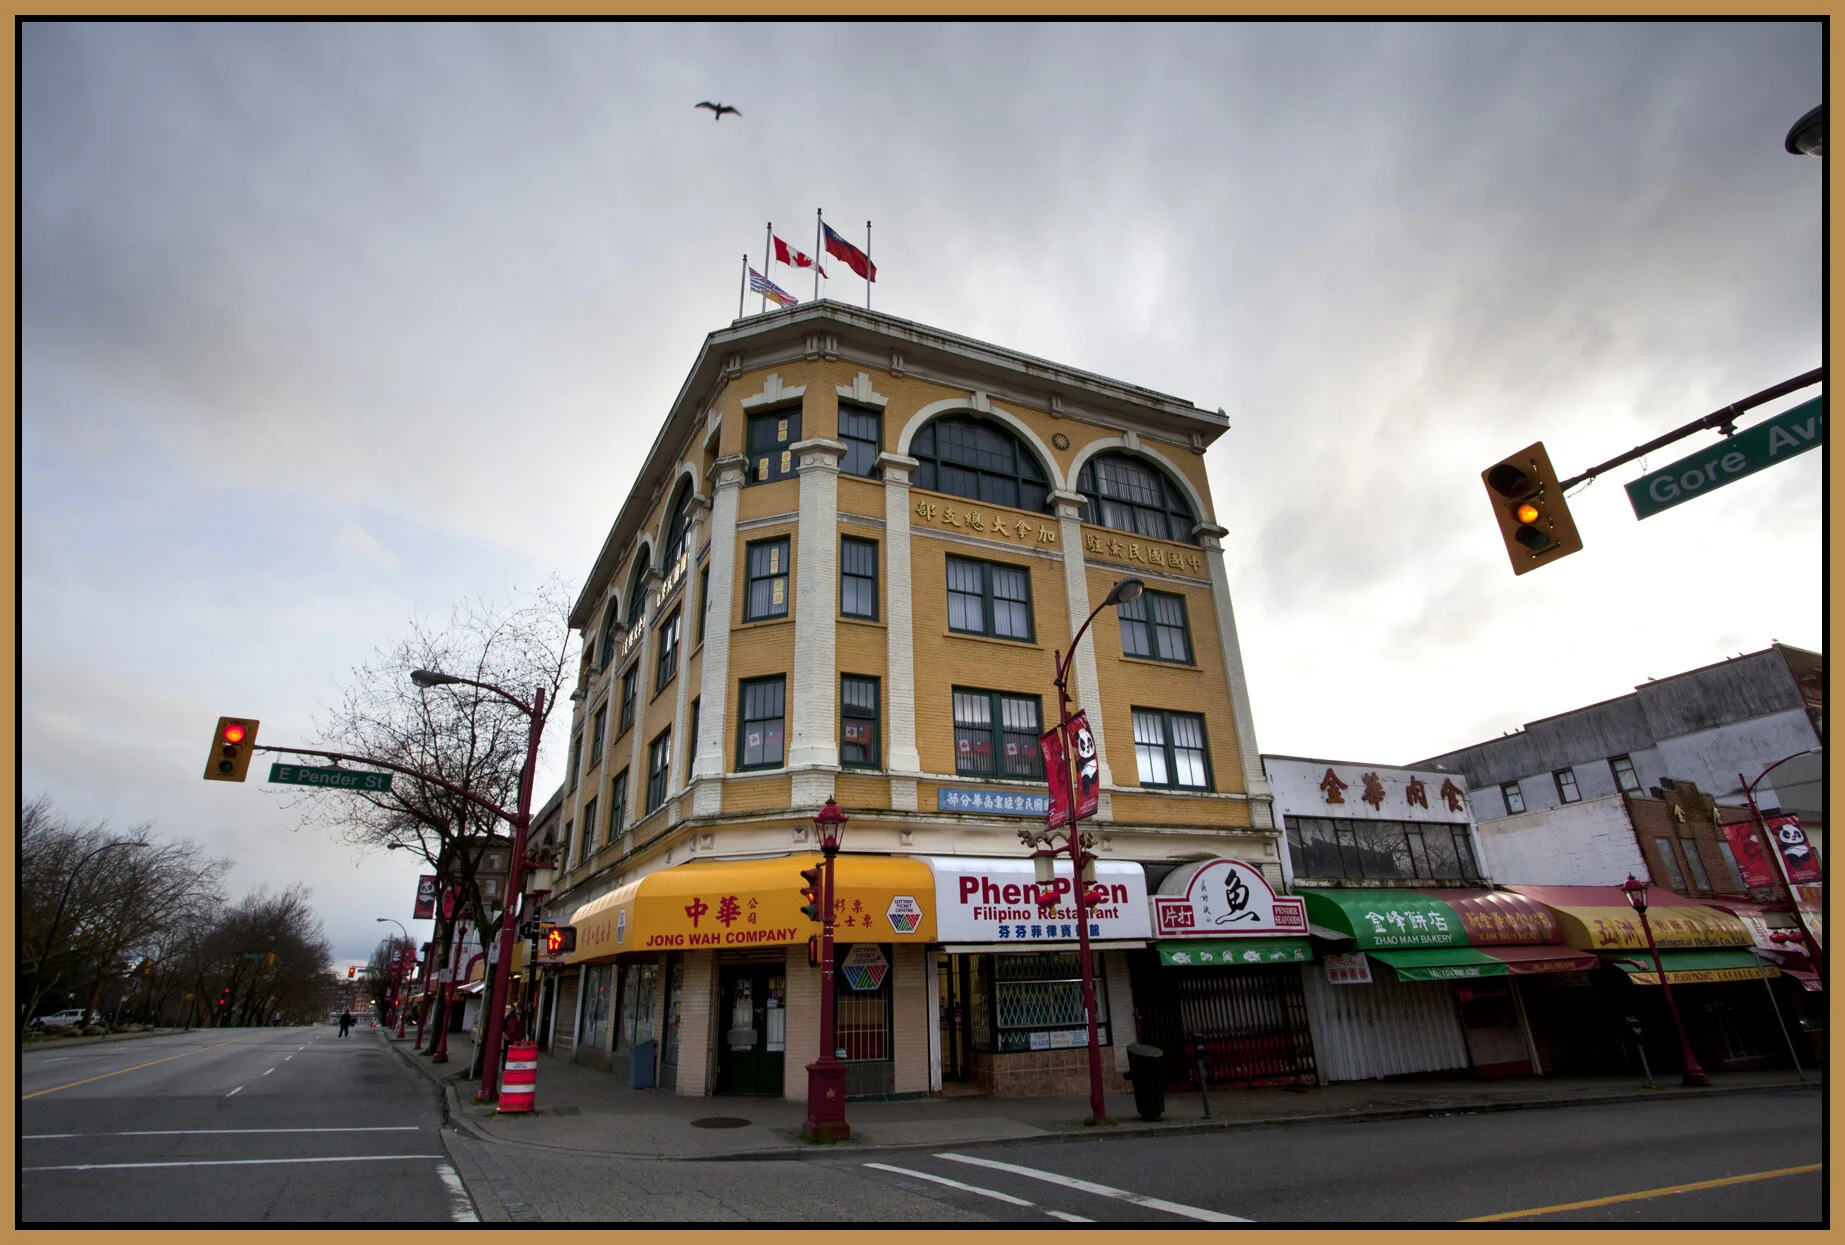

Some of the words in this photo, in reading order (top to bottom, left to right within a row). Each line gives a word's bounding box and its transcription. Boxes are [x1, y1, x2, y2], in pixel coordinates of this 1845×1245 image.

[1649, 450, 1747, 502] Gore
[1769, 413, 1822, 457] Av
[279, 767, 292, 780] E
[298, 769, 358, 787] Pender
[364, 775, 384, 789] St
[1320, 768, 1464, 812] 金華肉食
[959, 876, 1039, 904] Phen
[1053, 877, 1128, 904] Pen
[1215, 868, 1261, 925] 魚
[684, 896, 742, 928] 中華
[973, 906, 1031, 923] Filipino
[1275, 916, 1301, 924] SEAFOODS
[646, 934, 684, 947] JONG
[688, 933, 721, 945] WAH
[725, 928, 797, 944] COMPANY
[999, 924, 1100, 938] 芬芬菲律賓館
[1374, 936, 1398, 945] ZHAO
[1400, 935, 1419, 944] MAH
[1422, 934, 1452, 944] BAKERY
[1655, 937, 1692, 947] ontinental
